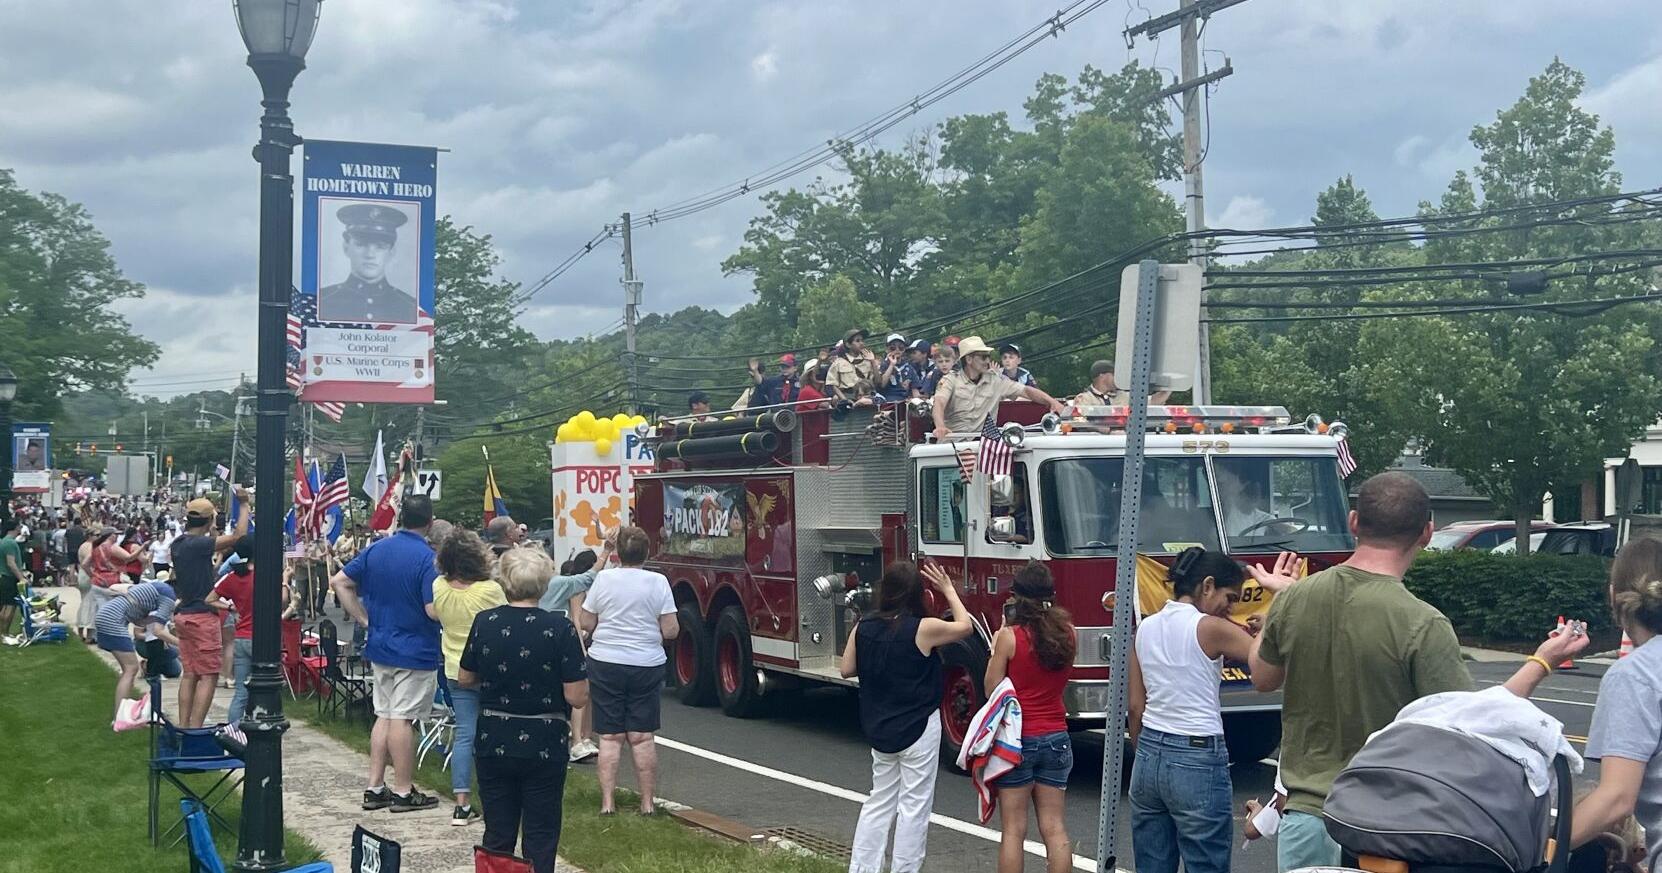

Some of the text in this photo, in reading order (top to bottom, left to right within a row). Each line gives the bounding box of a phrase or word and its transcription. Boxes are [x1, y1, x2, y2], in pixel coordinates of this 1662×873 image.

[341, 163, 401, 180] WARREN
[307, 177, 433, 198] HOMETOWN HERO
[338, 332, 397, 343] John Kolator
[347, 343, 389, 354] Corporal
[346, 356, 379, 367] Marine
[381, 358, 410, 369] Corps
[355, 367, 381, 377] WWII
[625, 434, 655, 460] PA
[576, 469, 637, 494] POPC
[674, 507, 729, 537] PACK 182
[1238, 586, 1263, 602] 82
